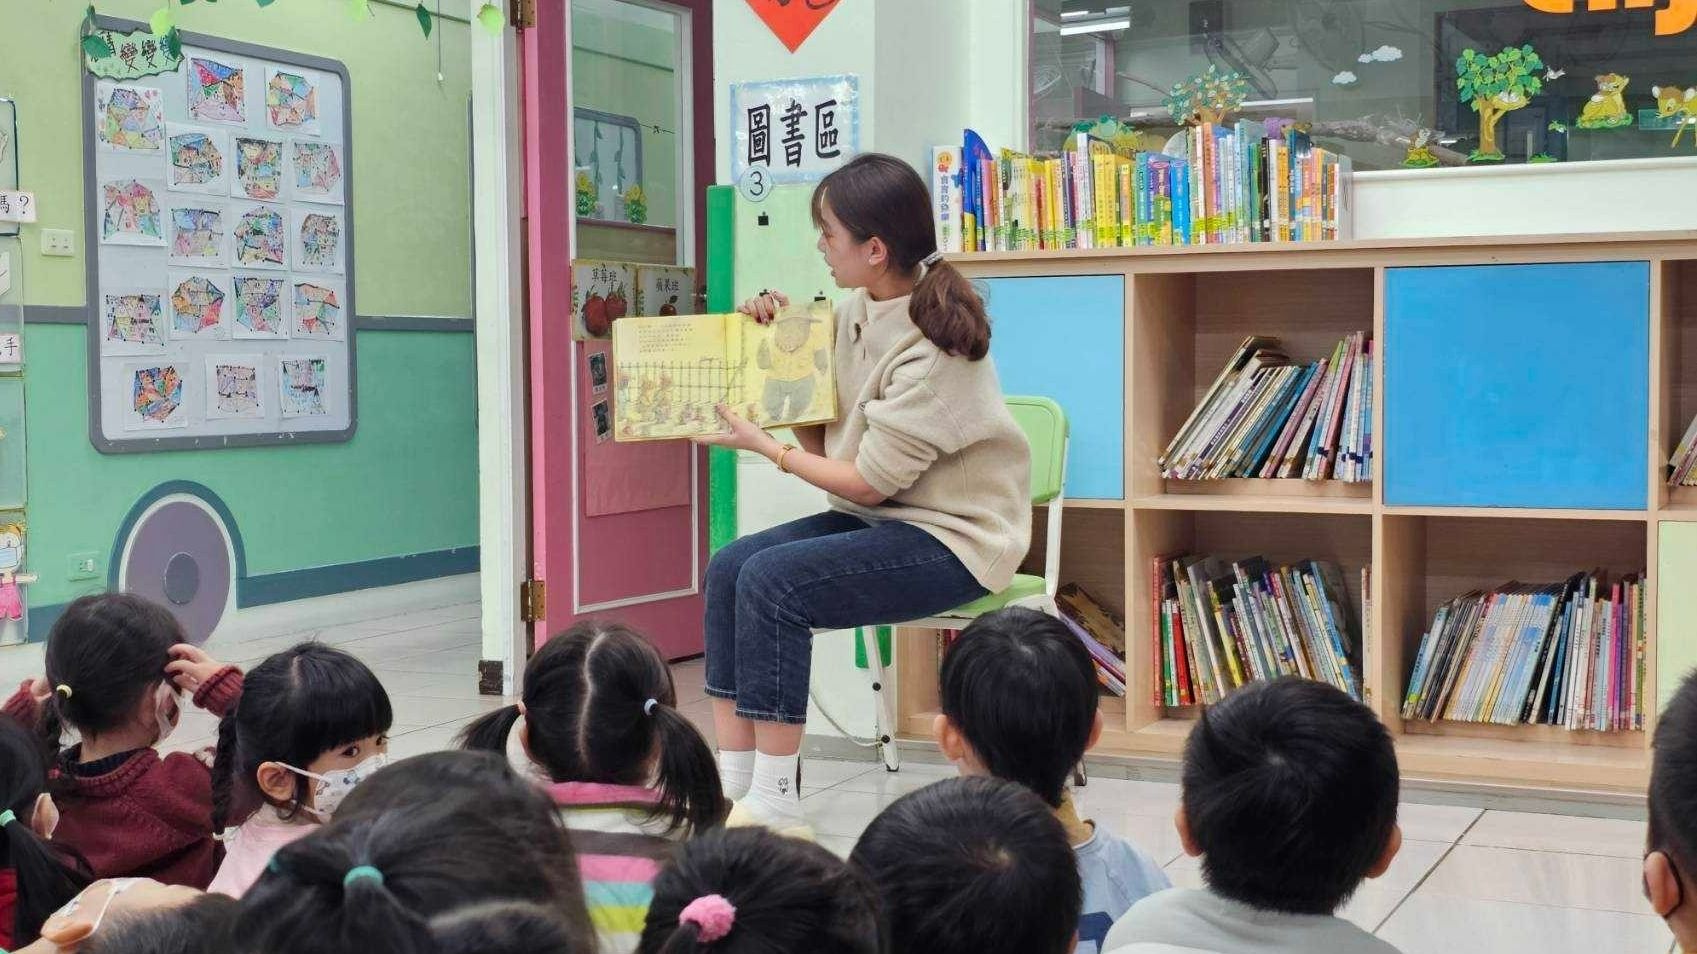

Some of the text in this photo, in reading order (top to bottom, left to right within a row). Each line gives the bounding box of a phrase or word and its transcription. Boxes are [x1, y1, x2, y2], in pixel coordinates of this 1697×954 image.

[747, 97, 841, 168] 圖書區
[750, 171, 769, 196] 3
[591, 267, 618, 286] 草莓班
[656, 278, 680, 292] 蘋果班
